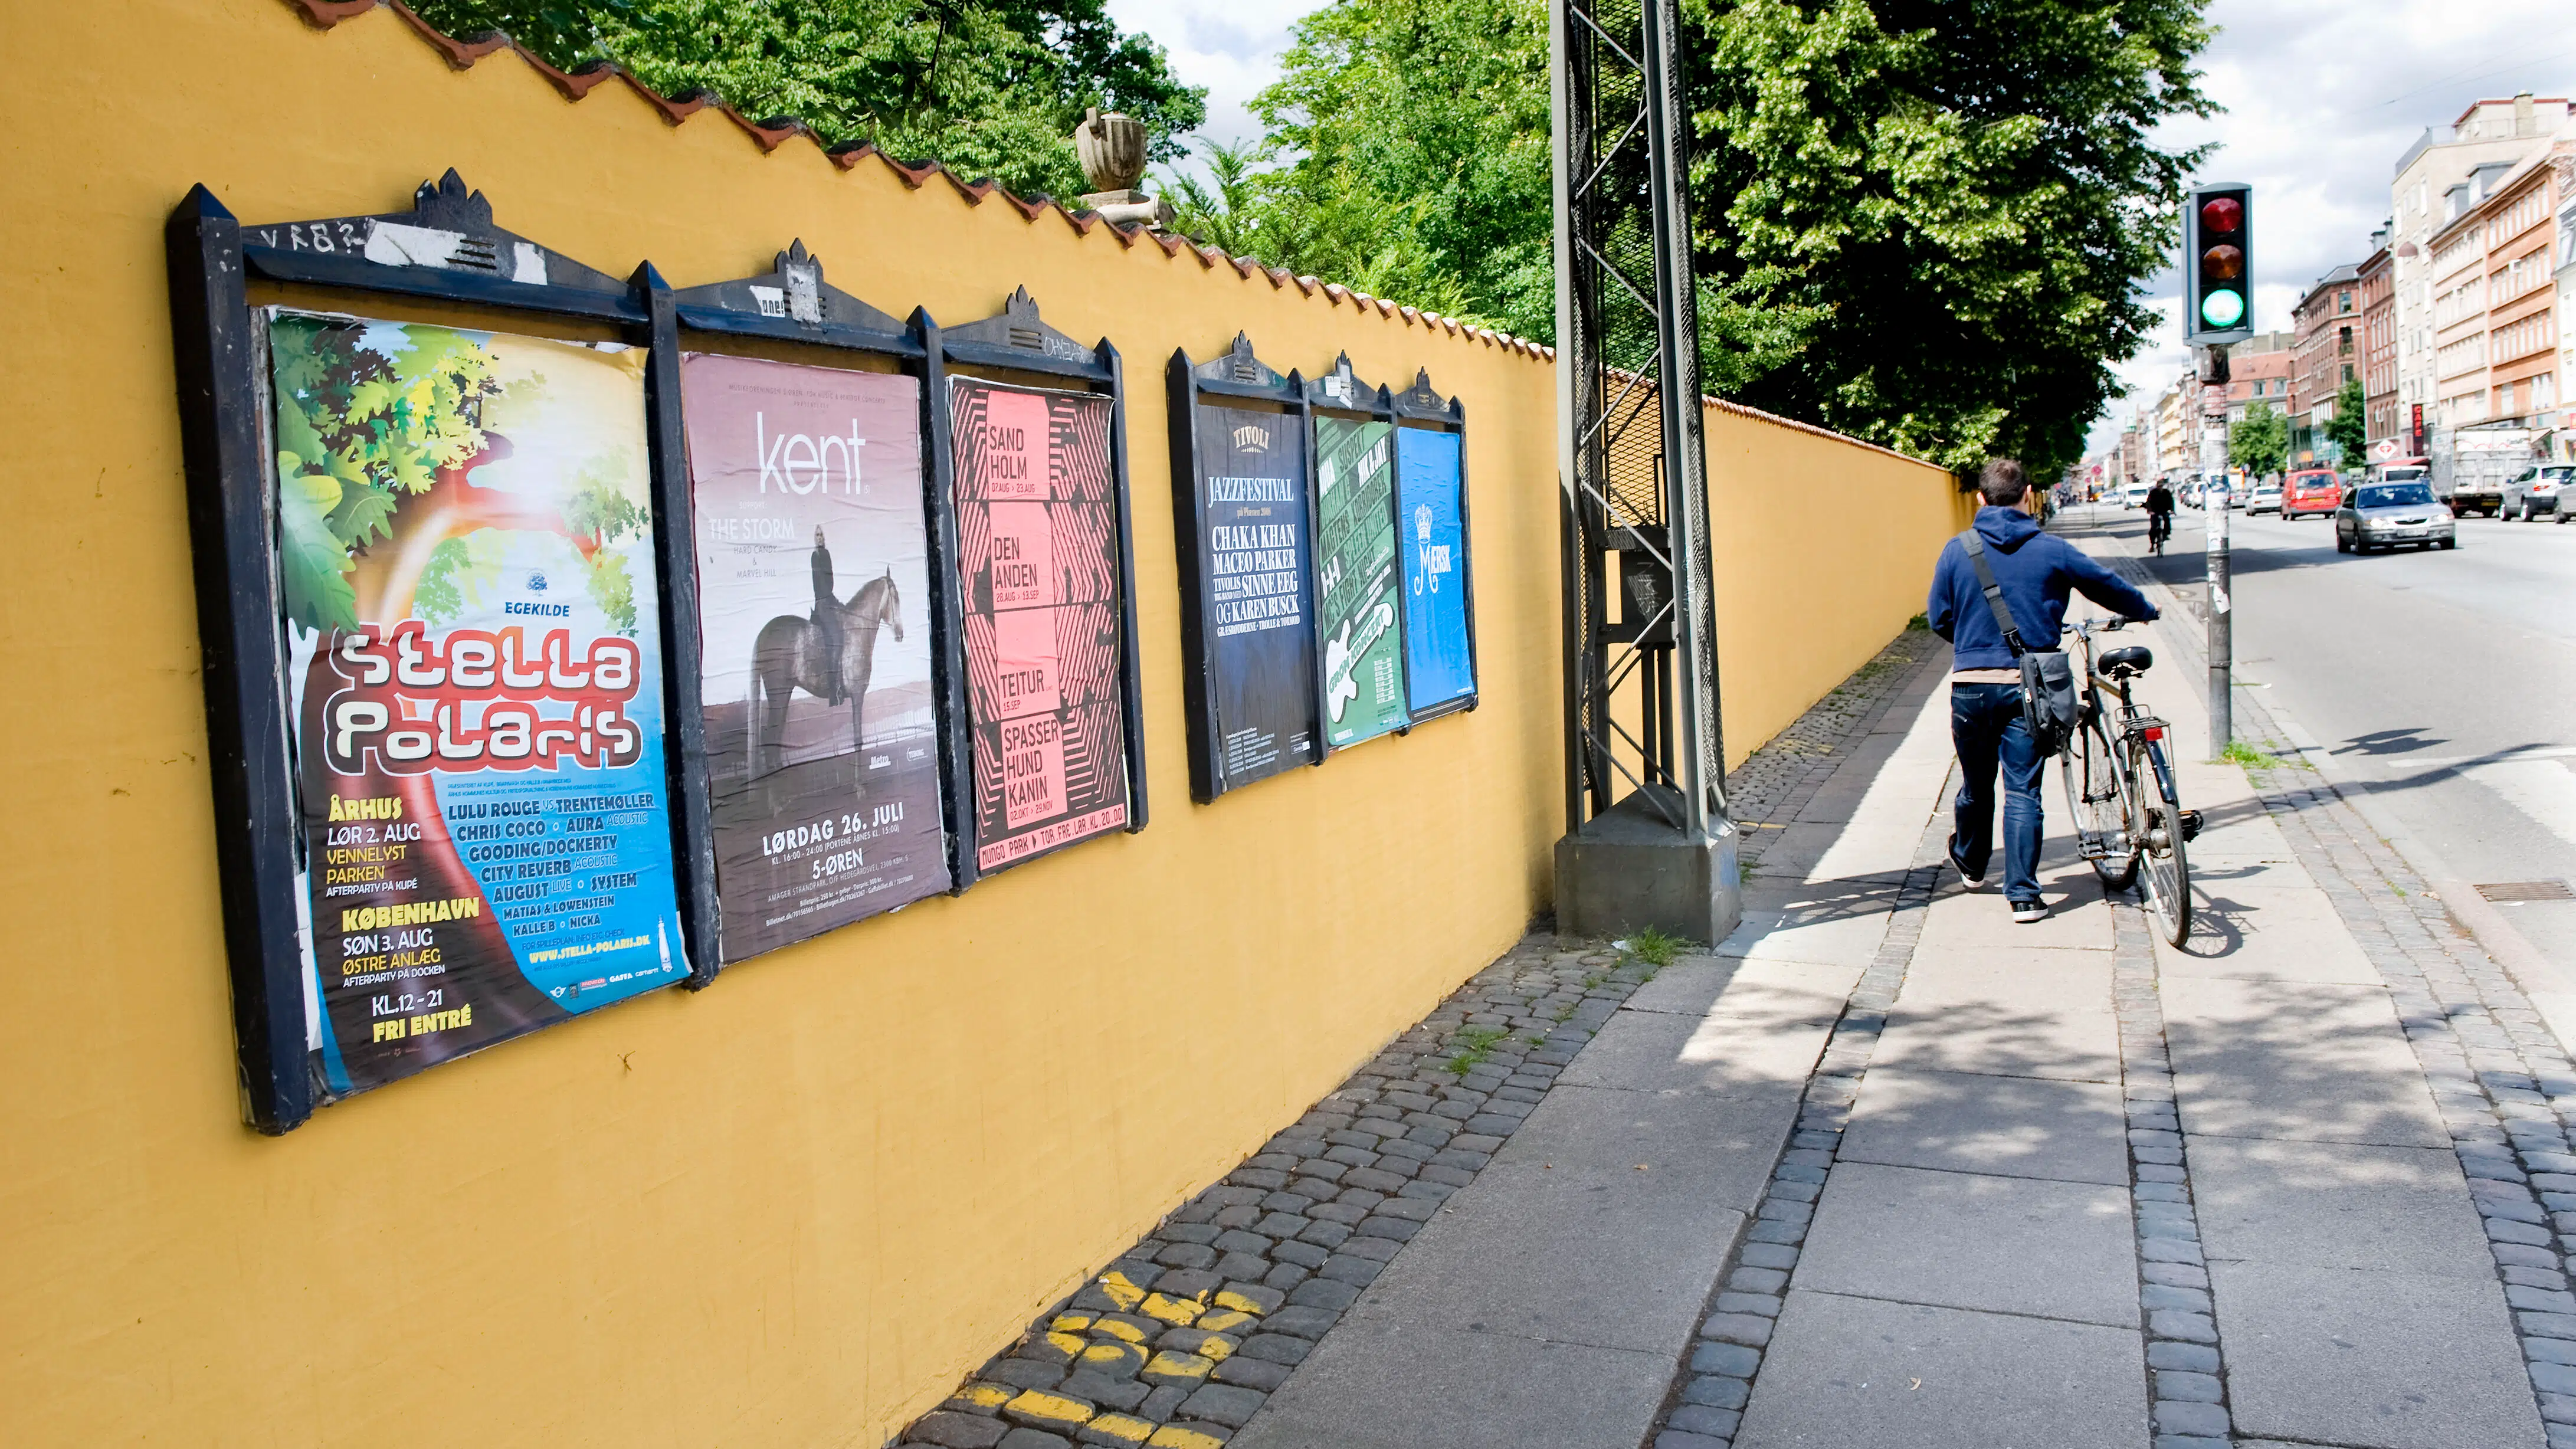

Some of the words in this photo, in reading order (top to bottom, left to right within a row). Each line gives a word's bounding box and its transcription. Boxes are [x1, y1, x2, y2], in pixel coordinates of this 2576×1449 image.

[989, 425, 1024, 453] SAND
[1233, 425, 1270, 450] TIVOLI
[1338, 427, 1365, 473] SUSPEKT
[757, 411, 866, 494] kent
[991, 455, 1027, 480] HOLM
[1016, 483, 1035, 493] 23.AUG
[1208, 477, 1294, 508] JAZZFESTIVAL
[709, 518, 738, 540] THE
[743, 517, 795, 539] STORM
[1320, 509, 1350, 560] MAGTENS
[1351, 470, 1387, 527] KORRIDORER
[733, 546, 752, 555] HARD
[753, 545, 777, 554] CANDY
[994, 537, 1020, 561] DEN
[1212, 526, 1258, 552] CHAKA
[1260, 524, 1295, 549] KHAN
[737, 570, 762, 578] MARVEL
[764, 569, 776, 577] HILL
[1212, 552, 1253, 575] MACEO
[1255, 549, 1296, 571] PARKER
[995, 564, 1038, 589] ANDEN
[1213, 576, 1241, 592] TIVOLIS
[1242, 573, 1276, 598] SINNE
[1276, 571, 1298, 594] EEG
[996, 592, 1015, 604] 28.AUG
[1339, 571, 1358, 610] FIGHT
[504, 602, 570, 617] EGEKILDE
[1216, 603, 1231, 624] OG
[1231, 598, 1267, 622] KAREN
[1267, 594, 1300, 617] BUSCK
[1351, 608, 1385, 661] KONCERT
[1000, 668, 1045, 699] TEITUR
[1005, 719, 1060, 752] SPASSER
[871, 755, 889, 765] Metro
[1006, 750, 1043, 780] HUND
[1008, 776, 1048, 808] KANIN
[328, 794, 402, 822] ÅRHUS
[449, 805, 486, 820] LULU
[491, 801, 540, 817] ROUGE
[556, 794, 654, 813] TRENTEMØLLER
[327, 825, 362, 845] LØR
[366, 827, 380, 844] 2.
[384, 822, 421, 842] AUG
[457, 825, 501, 841] CHRIS
[506, 821, 546, 837] COCO
[566, 817, 604, 832] AURA
[607, 812, 648, 827] ACOUSTIC
[763, 819, 834, 855] LØRDAG
[841, 812, 867, 835] 26.
[873, 802, 903, 827] JULI
[326, 844, 407, 865] VENNELYST
[469, 835, 617, 861] GOODING/DOCKERTY
[772, 855, 781, 866] KL.
[783, 850, 801, 863] 16:00
[806, 845, 824, 857] 24:00
[825, 837, 852, 856] (PORTENE
[853, 831, 870, 845] ÅBNES
[872, 830, 880, 840] KL.
[982, 845, 1005, 866] MUNGO
[1009, 837, 1028, 857] PARK
[326, 865, 385, 884] PARKEN
[481, 866, 513, 882] CITY
[518, 860, 572, 878] REVERB
[575, 855, 617, 869] ACOUSTIC
[812, 848, 864, 880] 5-ØREN
[326, 883, 381, 897] AFTERPARTY
[382, 881, 394, 892] PÅ
[395, 877, 418, 890] KUPÉ
[493, 883, 549, 903] AUGUST
[552, 880, 572, 893] LIVE
[591, 873, 637, 891] SYSTEM
[768, 891, 791, 903] AMAGER
[792, 881, 828, 896] STRANDPARK,
[880, 860, 892, 869] 2300
[342, 897, 480, 932] KØBENHAVN
[504, 906, 541, 920] MATIAS
[544, 904, 550, 914] &
[553, 896, 615, 913] LØWENSTEIN
[514, 922, 546, 936] KALLE
[549, 921, 555, 932] B
[569, 916, 601, 929] NICKA
[343, 933, 378, 956] SØN
[382, 936, 394, 951] 3.
[398, 928, 434, 949] AUG
[522, 942, 535, 950] FOR
[343, 955, 387, 975] ØSTRE
[389, 948, 441, 969] ANLÆG
[343, 972, 396, 988] AFTERPARTY
[398, 968, 409, 981] PÅ
[411, 964, 445, 978] DOCKEN
[427, 988, 443, 1008] 21
[373, 1018, 406, 1044] FRI
[411, 1003, 472, 1035] ENTRÉ
